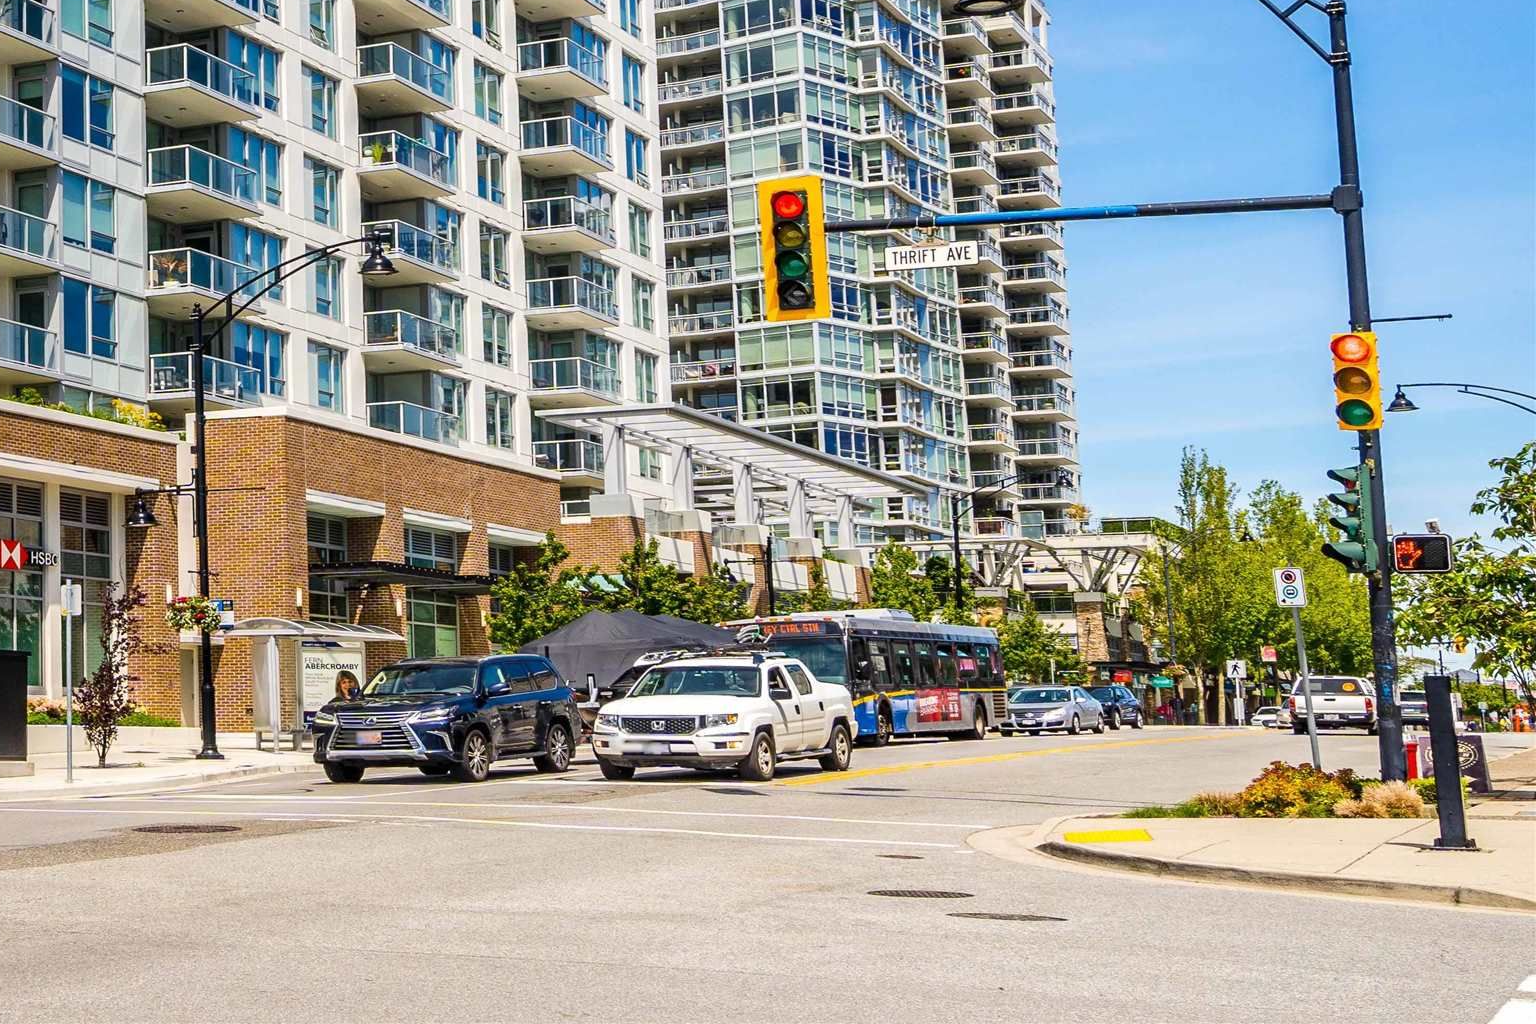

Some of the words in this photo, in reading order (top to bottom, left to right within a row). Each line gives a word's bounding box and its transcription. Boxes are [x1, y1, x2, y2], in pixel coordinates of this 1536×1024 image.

[892, 248, 937, 265] THRIFT
[946, 245, 972, 261] AVE
[31, 551, 59, 566] HSBC
